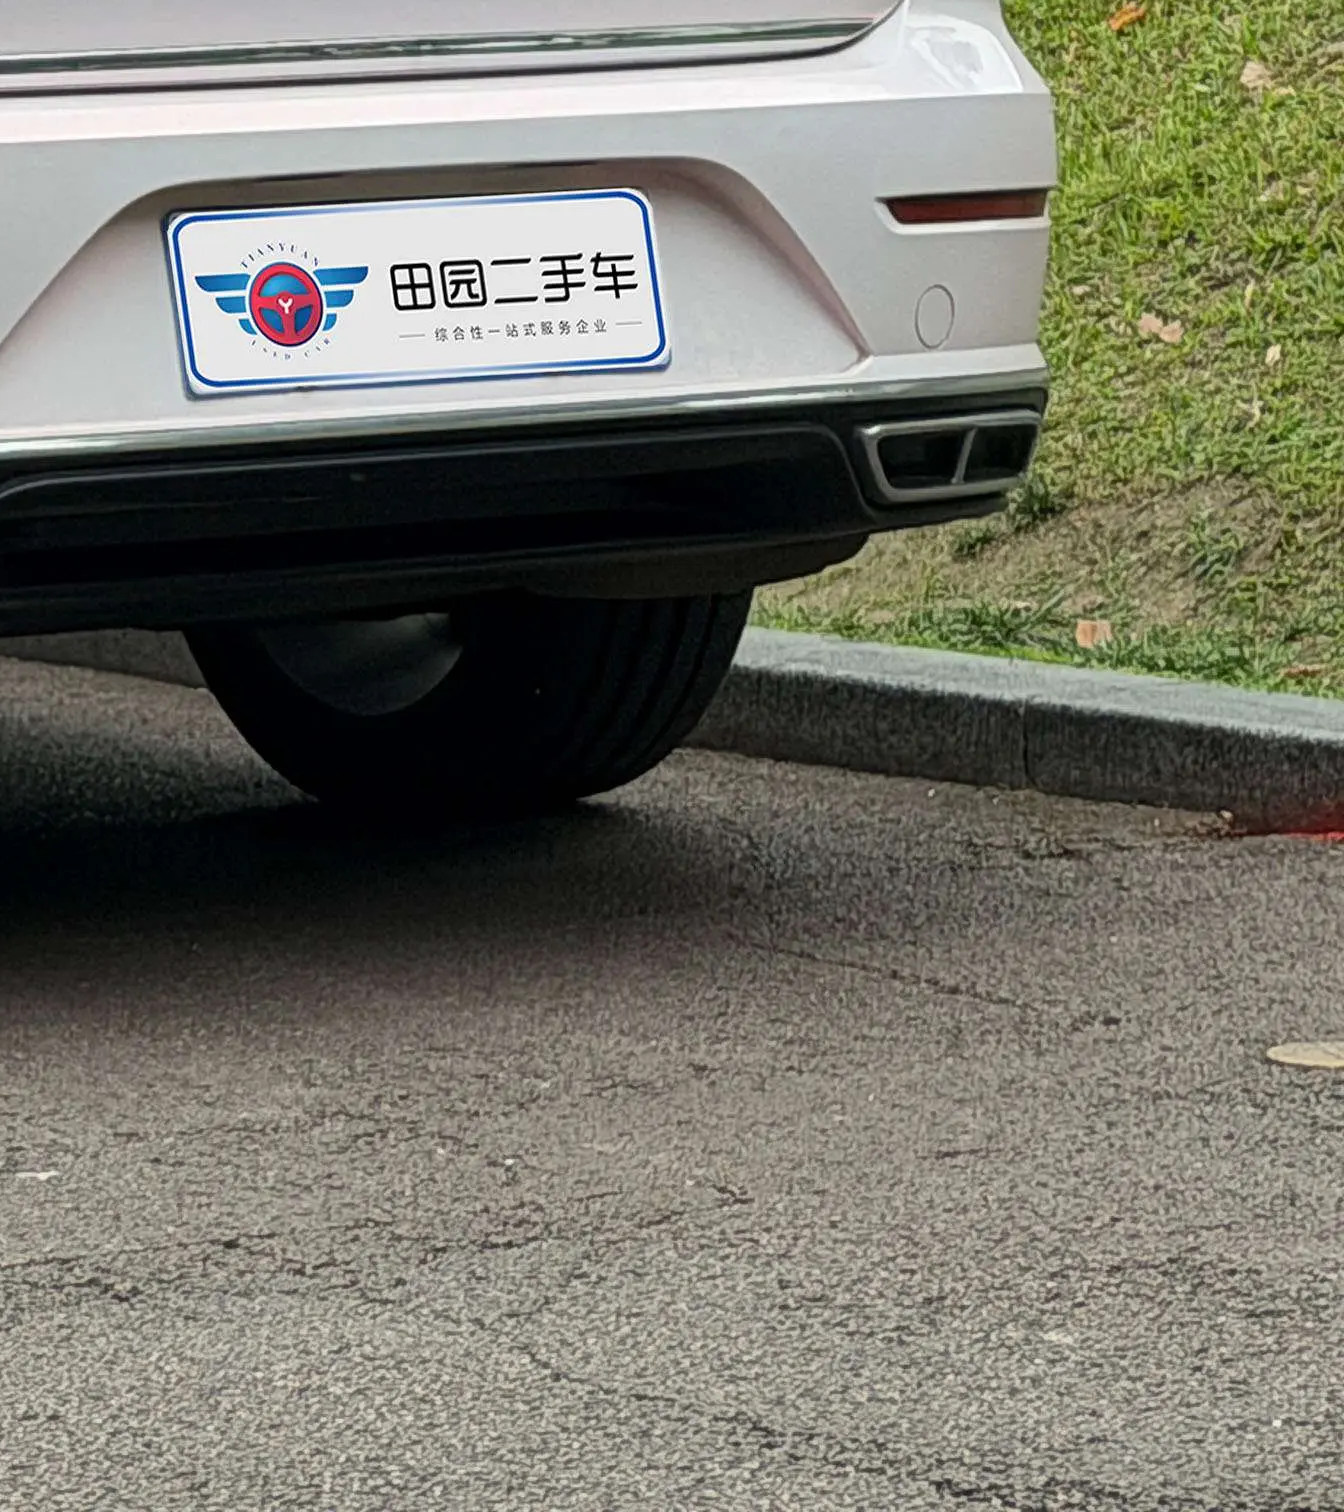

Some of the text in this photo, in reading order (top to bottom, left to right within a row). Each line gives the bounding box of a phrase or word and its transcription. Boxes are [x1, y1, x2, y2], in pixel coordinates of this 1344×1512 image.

[389, 251, 639, 312] 田园二手车
[433, 318, 608, 343] 综合性一站式服务企业
